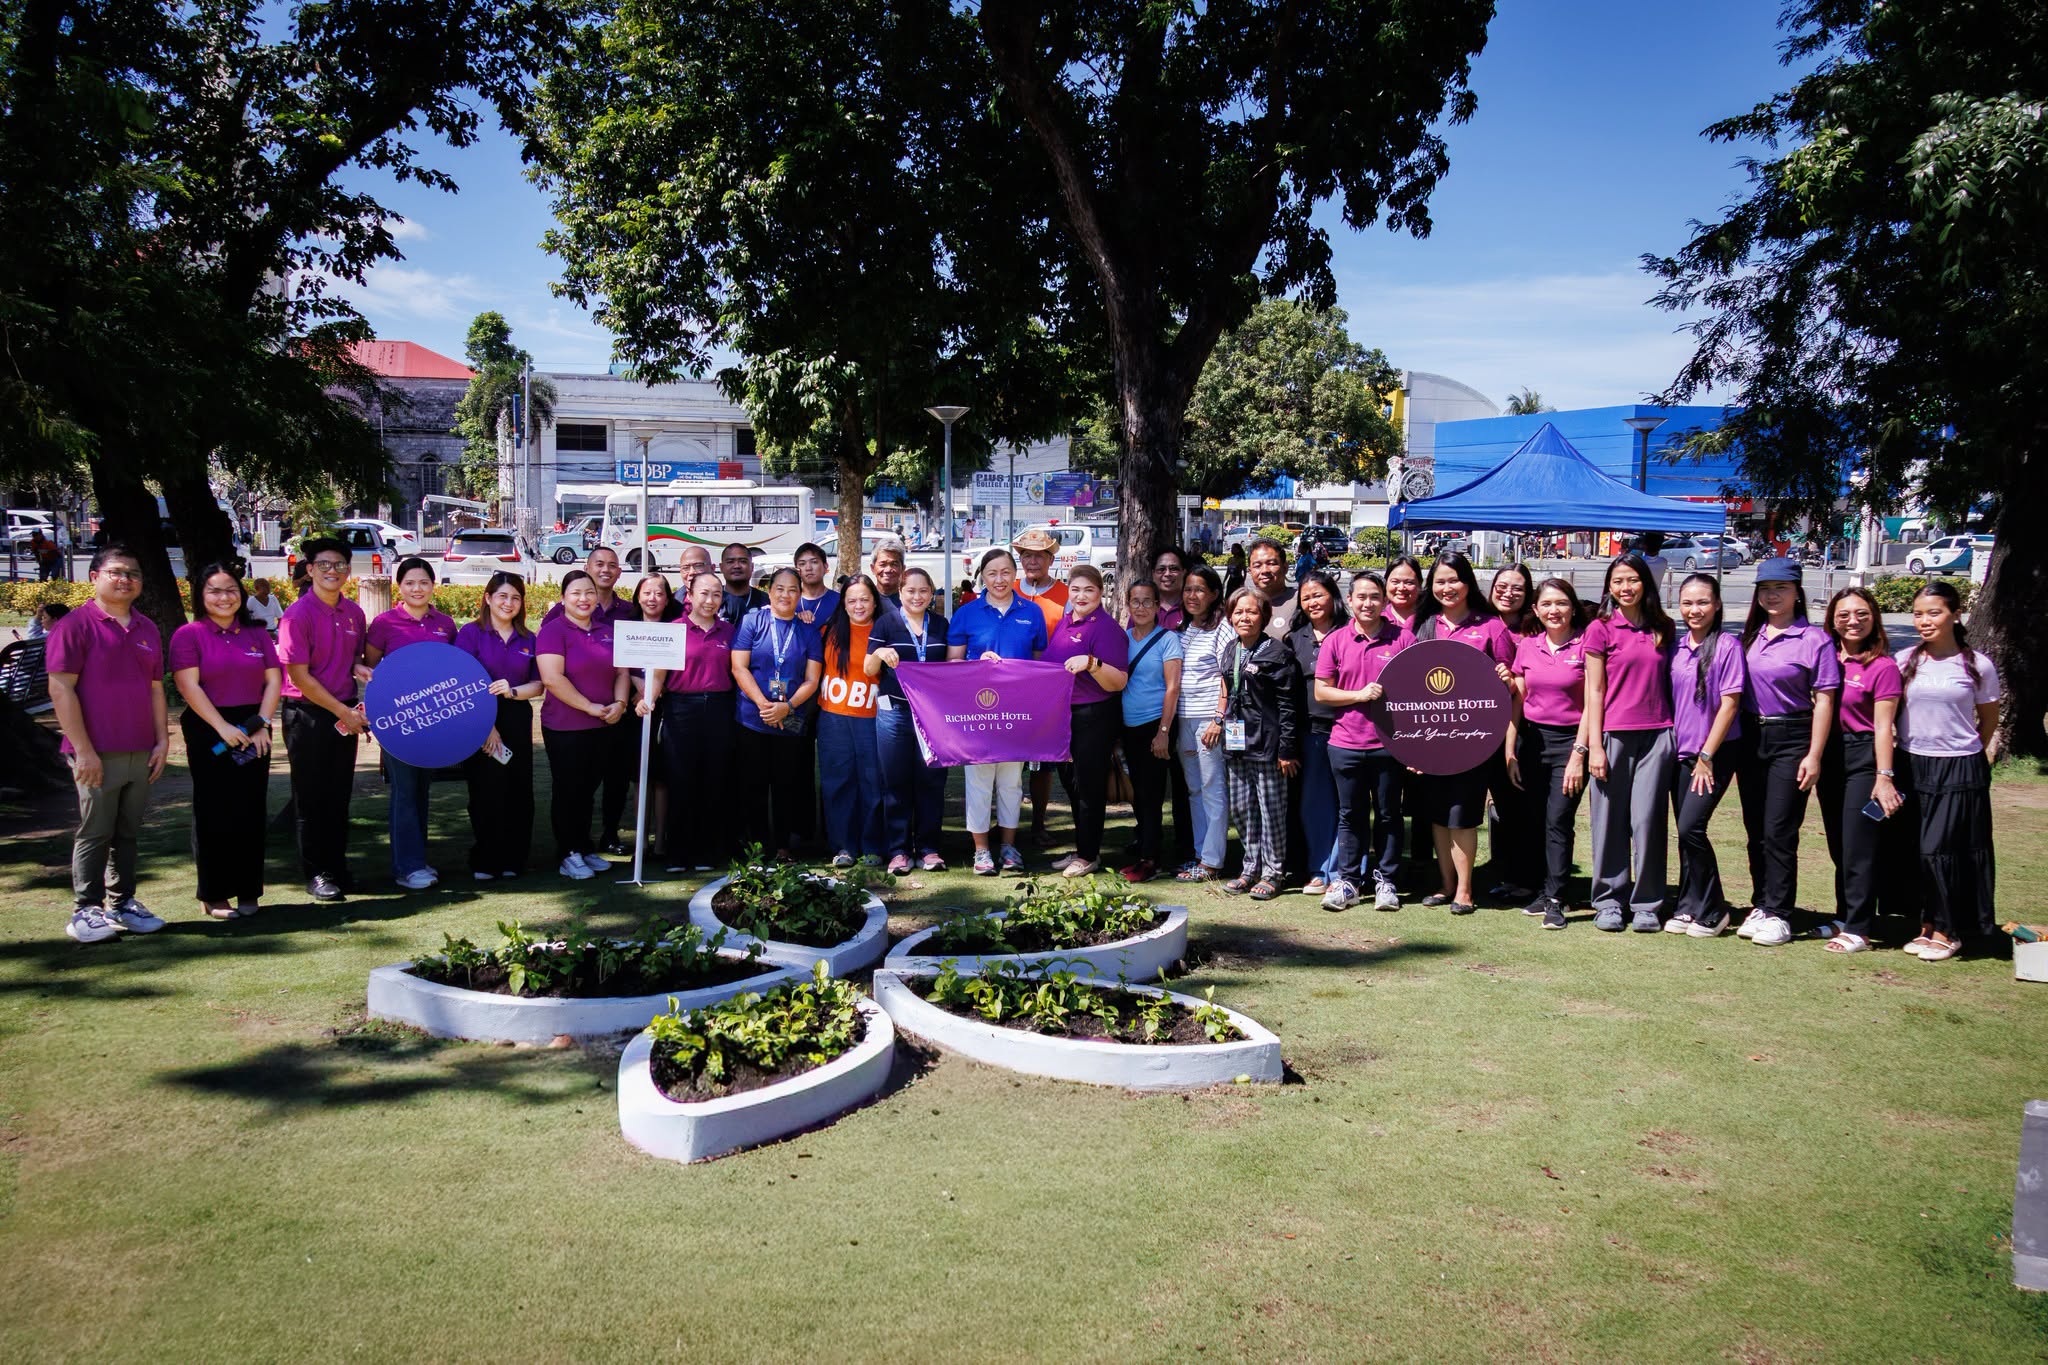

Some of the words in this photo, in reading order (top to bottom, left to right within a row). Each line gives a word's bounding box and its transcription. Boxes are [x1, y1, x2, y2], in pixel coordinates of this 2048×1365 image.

[640, 464, 672, 479] DBP
[976, 474, 1004, 482] PIUS
[1060, 555, 1078, 563] MJ-29
[625, 634, 674, 643] SAMPAGUITA
[393, 677, 458, 708] MEGAWORLD
[375, 702, 432, 730] GLOBAL
[432, 678, 488, 708] HOTELS
[1385, 700, 1455, 711] RICHMONDE
[1458, 699, 1498, 709] HOTEL
[400, 722, 415, 736] &
[415, 698, 475, 730] RESORTS
[944, 713, 999, 722] RICHMONDE
[1001, 712, 1032, 721] HOTEL
[1414, 713, 1469, 723] ILOILO
[963, 722, 1013, 731] ILOILO
[1392, 729, 1424, 740] Enrich
[1449, 729, 1493, 739] Everyday
